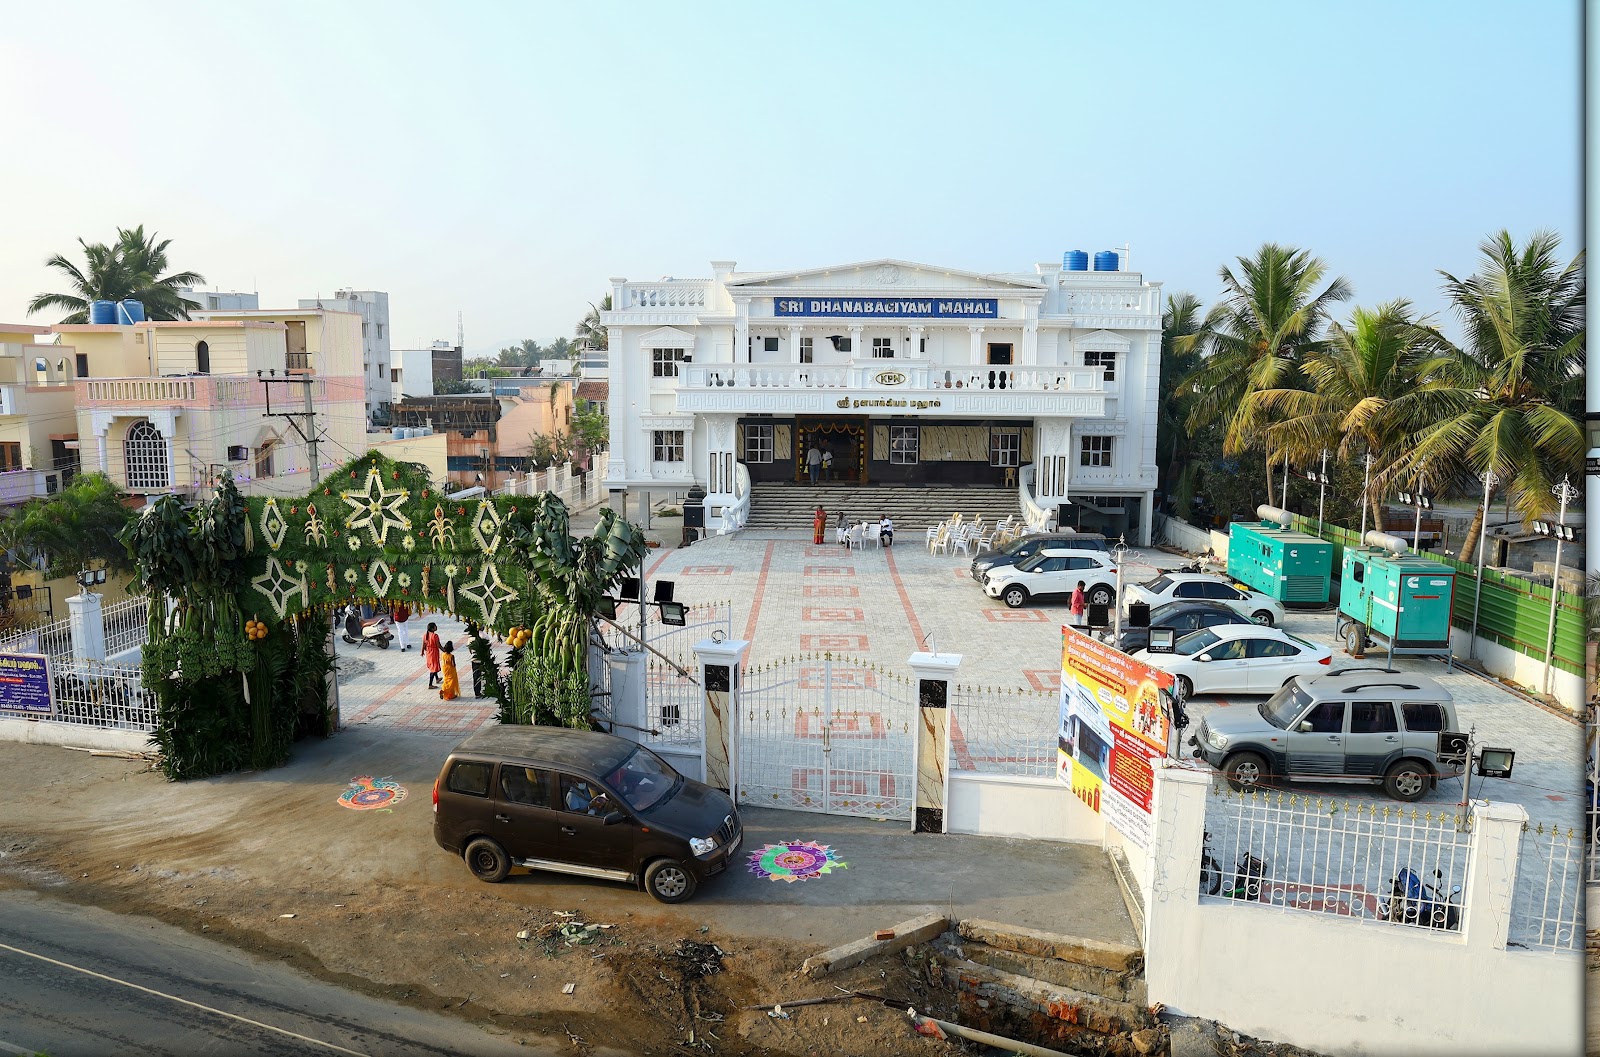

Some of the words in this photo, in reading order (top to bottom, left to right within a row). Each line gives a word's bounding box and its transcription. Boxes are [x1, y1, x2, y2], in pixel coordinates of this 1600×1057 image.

[778, 300, 804, 313] SRI
[810, 300, 932, 314] DHANABAGIYAM
[938, 301, 993, 314] MAHAL
[878, 374, 902, 384] KPN
